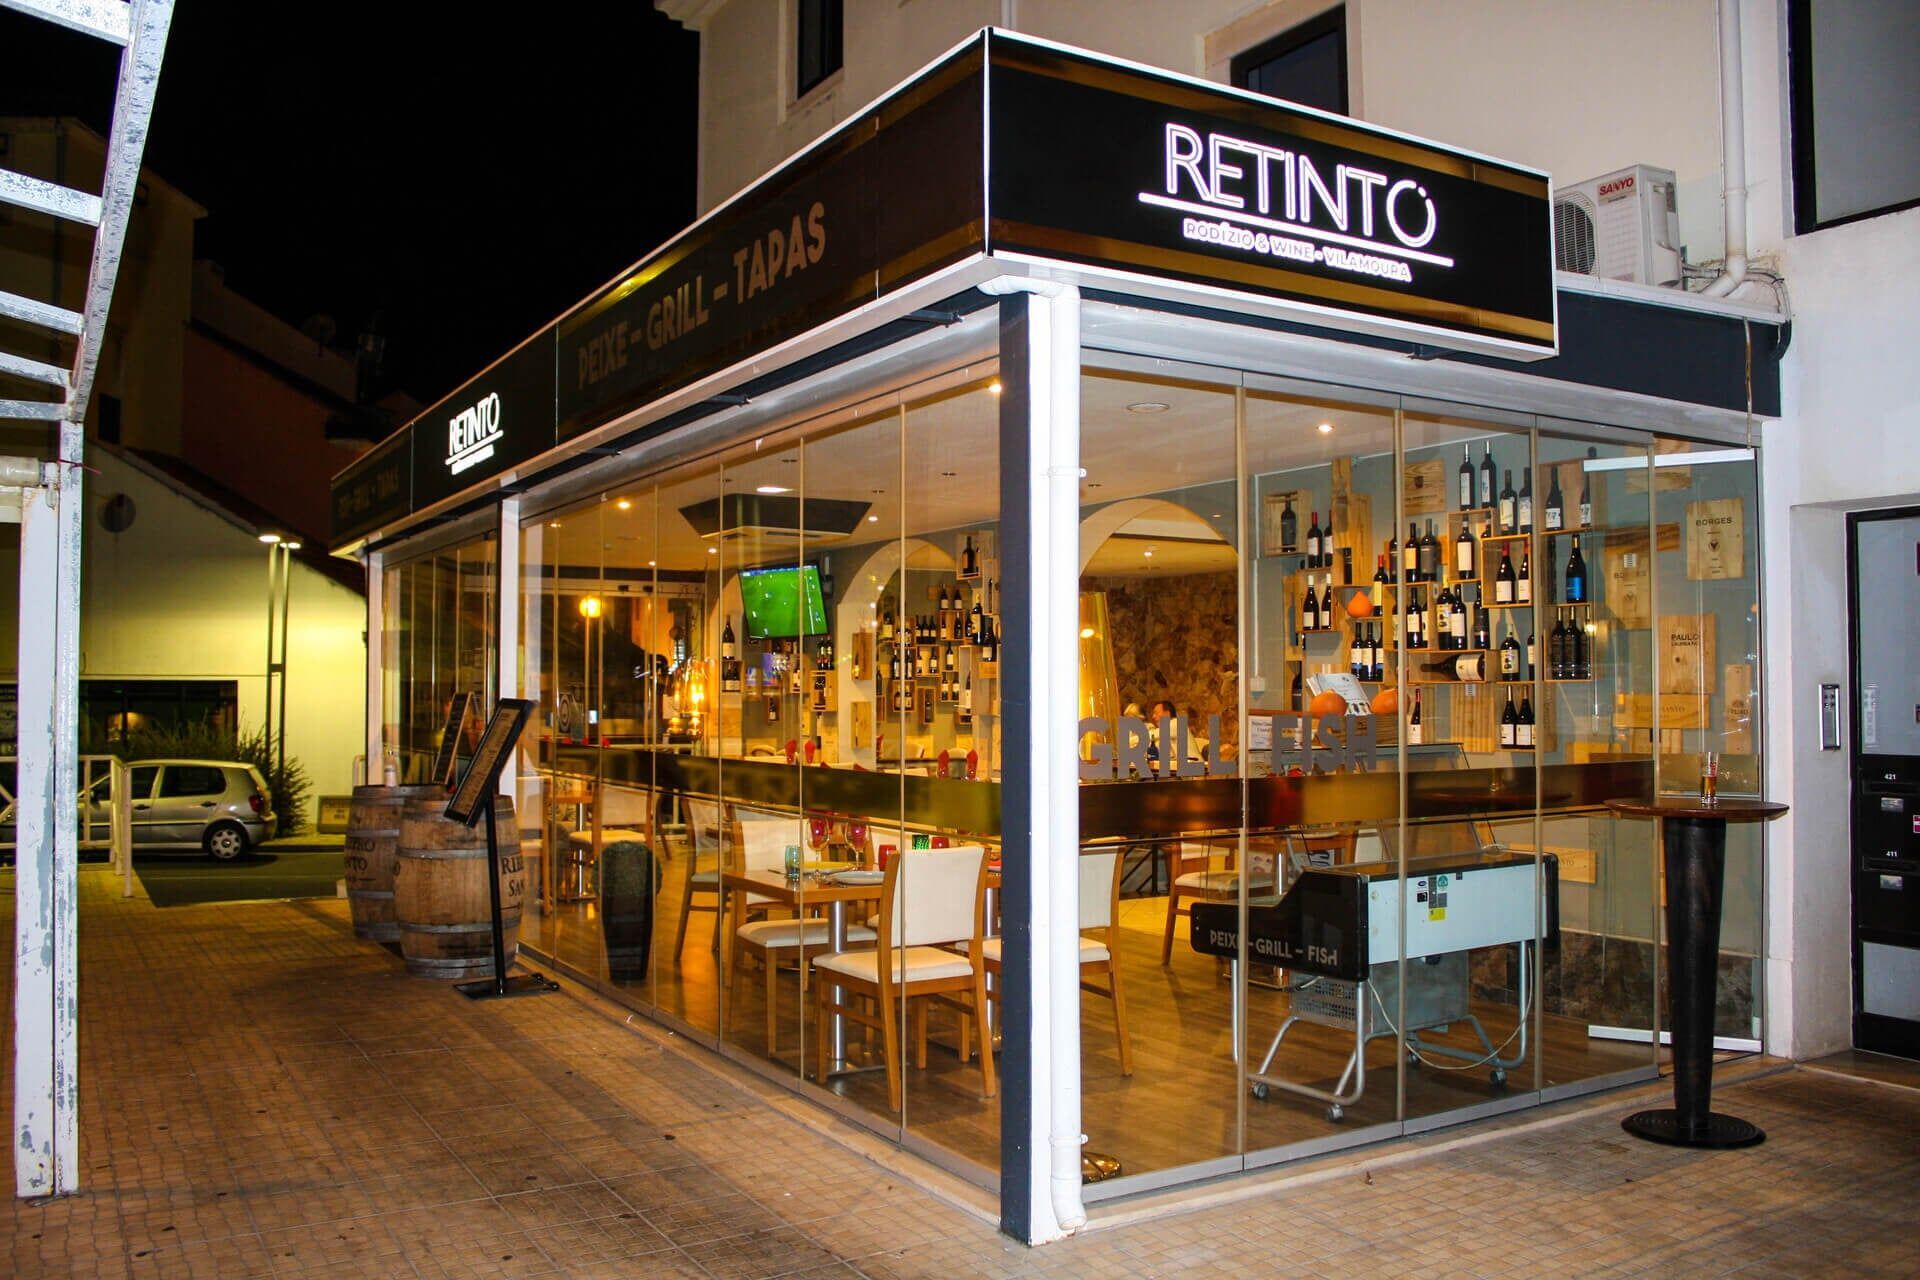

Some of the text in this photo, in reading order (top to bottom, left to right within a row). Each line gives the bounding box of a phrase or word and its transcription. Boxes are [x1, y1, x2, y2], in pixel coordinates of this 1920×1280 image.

[1165, 123, 1438, 248] RETINTO
[1600, 177, 1634, 196] SANYO
[1270, 235, 1315, 263] WINE
[1322, 246, 1412, 283] VILAMOURA
[578, 320, 629, 391] PEIXE
[646, 274, 709, 350] GRILL
[733, 201, 826, 304] TAPAS
[449, 392, 500, 456] RETINTO
[1695, 516, 1733, 527] BORGES
[1078, 711, 1376, 780] GRILL FISH
[1209, 929, 1239, 949] PEIX
[1255, 937, 1293, 959] GRILL
